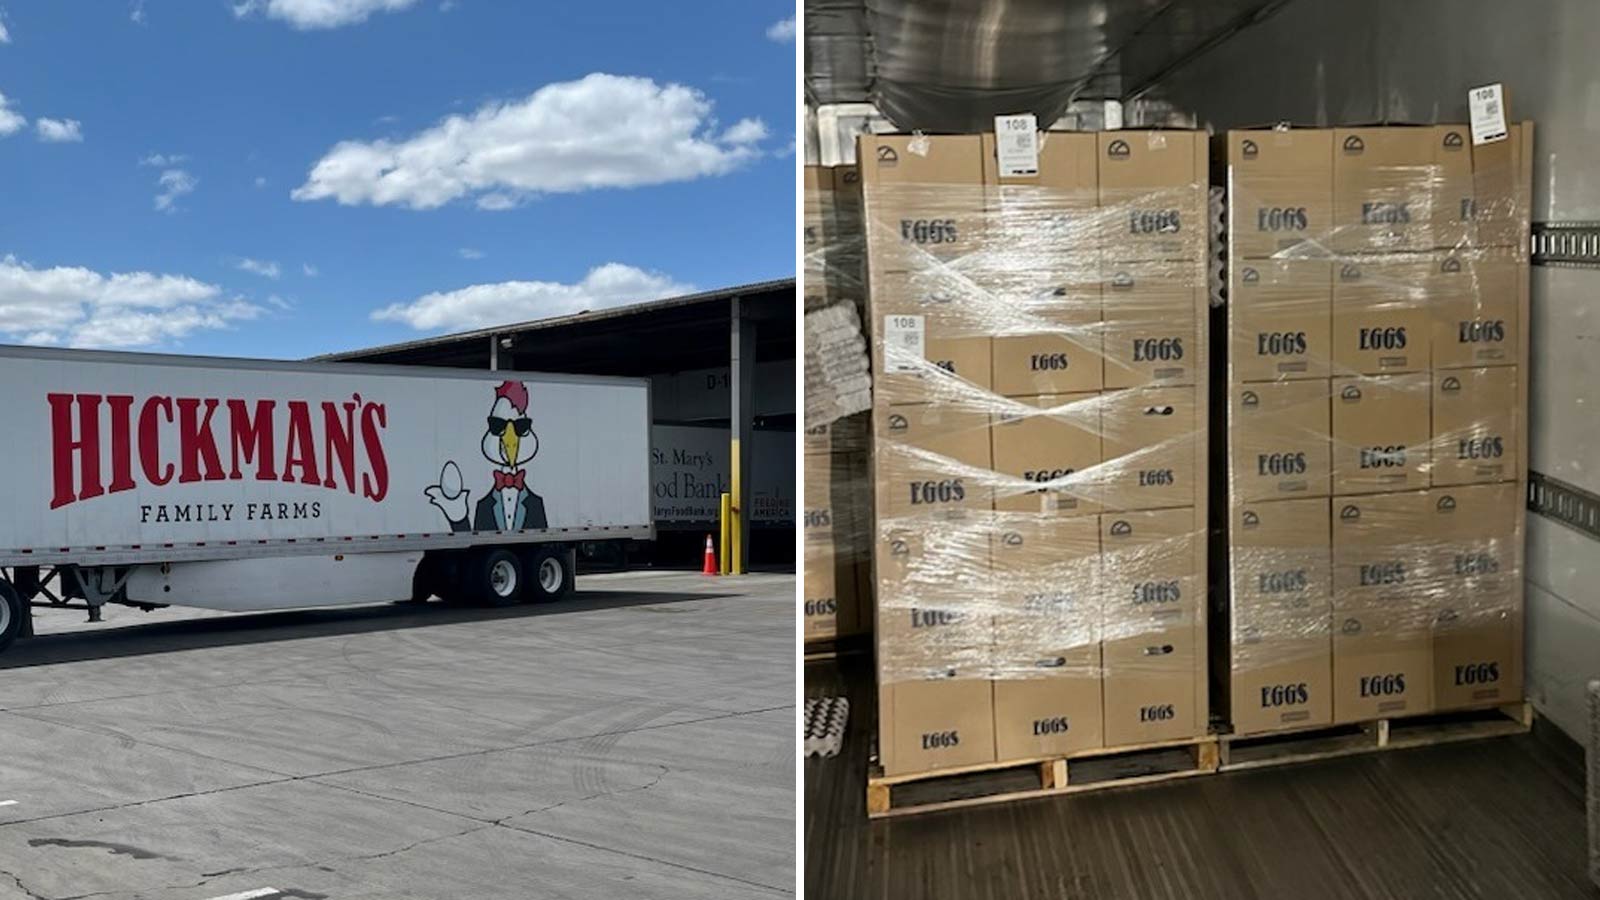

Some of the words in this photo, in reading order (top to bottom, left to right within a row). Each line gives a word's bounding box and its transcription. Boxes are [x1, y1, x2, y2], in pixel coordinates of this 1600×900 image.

[1476, 88, 1495, 101] 108
[1005, 119, 1027, 131] 108
[901, 218, 957, 244] EGGS
[1129, 209, 1180, 235] EGGS
[1258, 207, 1307, 232] EGGS
[893, 318, 915, 328] 108
[1459, 320, 1504, 343] EGGS
[1133, 337, 1183, 362] EGGS
[1258, 332, 1307, 355] EGGS
[1359, 327, 1406, 350] EGGS
[1031, 353, 1068, 371] EGGS
[707, 373, 731, 390] D-1
[47, 392, 389, 510] HICKMAN'S
[652, 447, 669, 465] St.
[673, 449, 713, 470] Mary's
[1360, 445, 1407, 469] EGGS
[1458, 437, 1503, 460] EGGS
[1258, 453, 1306, 476] EGGS
[653, 471, 678, 499] od
[684, 472, 729, 499] Bank
[1139, 469, 1174, 486] EGGS
[910, 480, 965, 505] EGGS
[140, 504, 233, 523] FAMILY
[247, 501, 322, 521] FARMS
[753, 508, 789, 517] AMERICA
[1360, 561, 1406, 586] EGGS
[1454, 553, 1499, 576] EGGS
[1132, 580, 1180, 604] EGGS
[1259, 570, 1306, 594] EGGS
[1360, 674, 1405, 697] EGGS
[1454, 662, 1499, 686] EGGS
[1261, 683, 1308, 708] EGGS
[1141, 704, 1174, 722] EGGS
[1033, 717, 1068, 735] EGGS
[922, 730, 958, 749] EGGS
